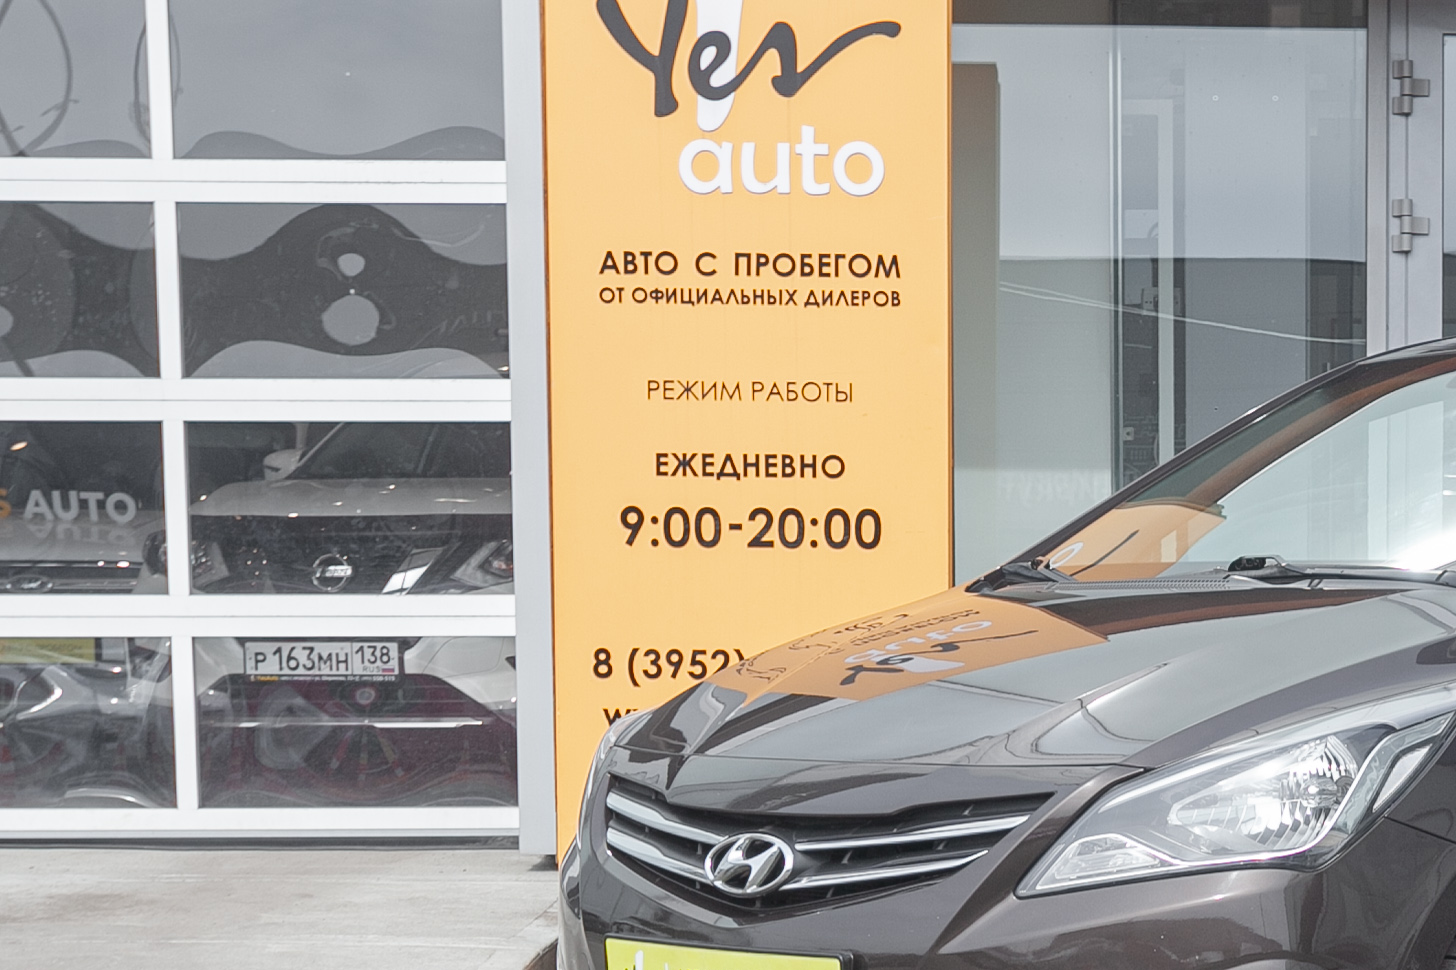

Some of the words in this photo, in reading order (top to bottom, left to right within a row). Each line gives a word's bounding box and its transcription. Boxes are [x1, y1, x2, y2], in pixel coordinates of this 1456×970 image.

[596, 0, 902, 118] Yes
[678, 124, 886, 197] auto
[598, 250, 679, 277] АВТО
[695, 252, 718, 277] С
[734, 252, 901, 279] ПРОБЕГОМ
[599, 286, 625, 304] ОТ
[631, 287, 798, 308] ОФИЦИАЛЬНЫХ
[804, 289, 901, 308] ДИЛЕРОВ
[647, 379, 742, 402] РЕЖИМ
[751, 381, 854, 403] РАБОТЫ
[655, 452, 846, 480] ЕЖЕДНЕВНО
[24, 489, 137, 525] AUTO
[620, 505, 882, 550] 9:00-20:00
[355, 645, 391, 664] 138
[593, 647, 613, 679] 8
